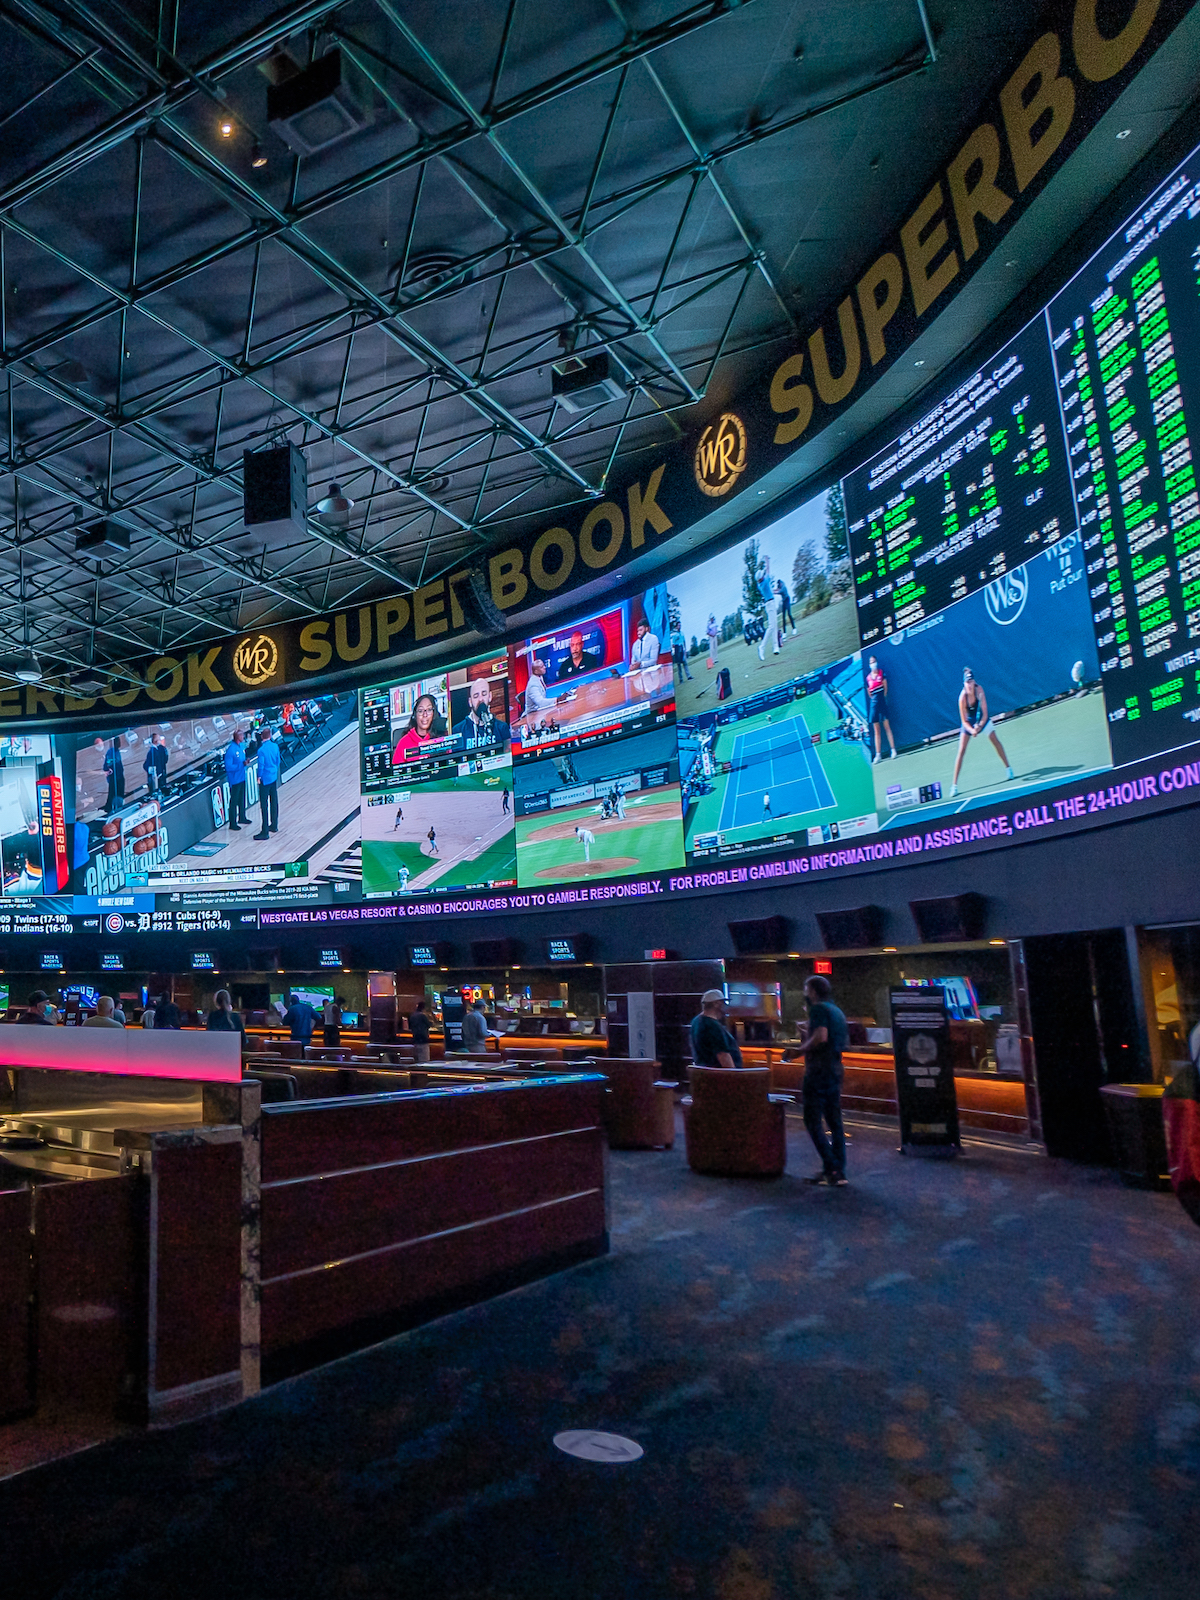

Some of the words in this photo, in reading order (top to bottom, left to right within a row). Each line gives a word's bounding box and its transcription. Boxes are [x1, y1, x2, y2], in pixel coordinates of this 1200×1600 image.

[1051, 580, 1066, 594] Put
[1067, 569, 1083, 585] our
[906, 615, 945, 638] Insurance
[40, 788, 53, 837] BLUES
[53, 781, 66, 854] PANTHERS
[261, 912, 309, 923] WESTGATE
[310, 911, 327, 922] LAS
[329, 909, 359, 920] VEGAS
[361, 907, 397, 919] RESORT
[399, 907, 406, 917] &
[407, 904, 442, 916] CASINO
[443, 896, 507, 913] ENCOURAGES
[509, 895, 529, 908] YOU
[531, 894, 545, 906] TO
[547, 889, 588, 904] GAMBLE
[590, 880, 663, 900] RESPONSIBLY.
[669, 877, 693, 891] FOR
[694, 868, 748, 888] PROBLEM
[749, 858, 809, 880] GAMBLING
[811, 843, 893, 870] INFORMATION
[895, 836, 922, 856] AND
[924, 816, 1013, 851] ASSISTANCE,
[1013, 806, 1054, 830] CALL
[1053, 796, 1086, 821] THE
[1088, 776, 1159, 813] 24-HOUR
[1159, 762, 1200, 792] CON
[223, 866, 253, 874] MILWAUKEE
[14, 915, 38, 923] Twins
[40, 915, 68, 925] (17-10)
[152, 912, 172, 921] #911
[176, 912, 196, 920] Cubs
[197, 911, 221, 920] (16-9)
[13, 924, 44, 933] Indians
[45, 924, 73, 934] (16-10)
[152, 922, 173, 931] #912
[176, 921, 201, 932] Tigers
[202, 920, 231, 931] (10-14)
